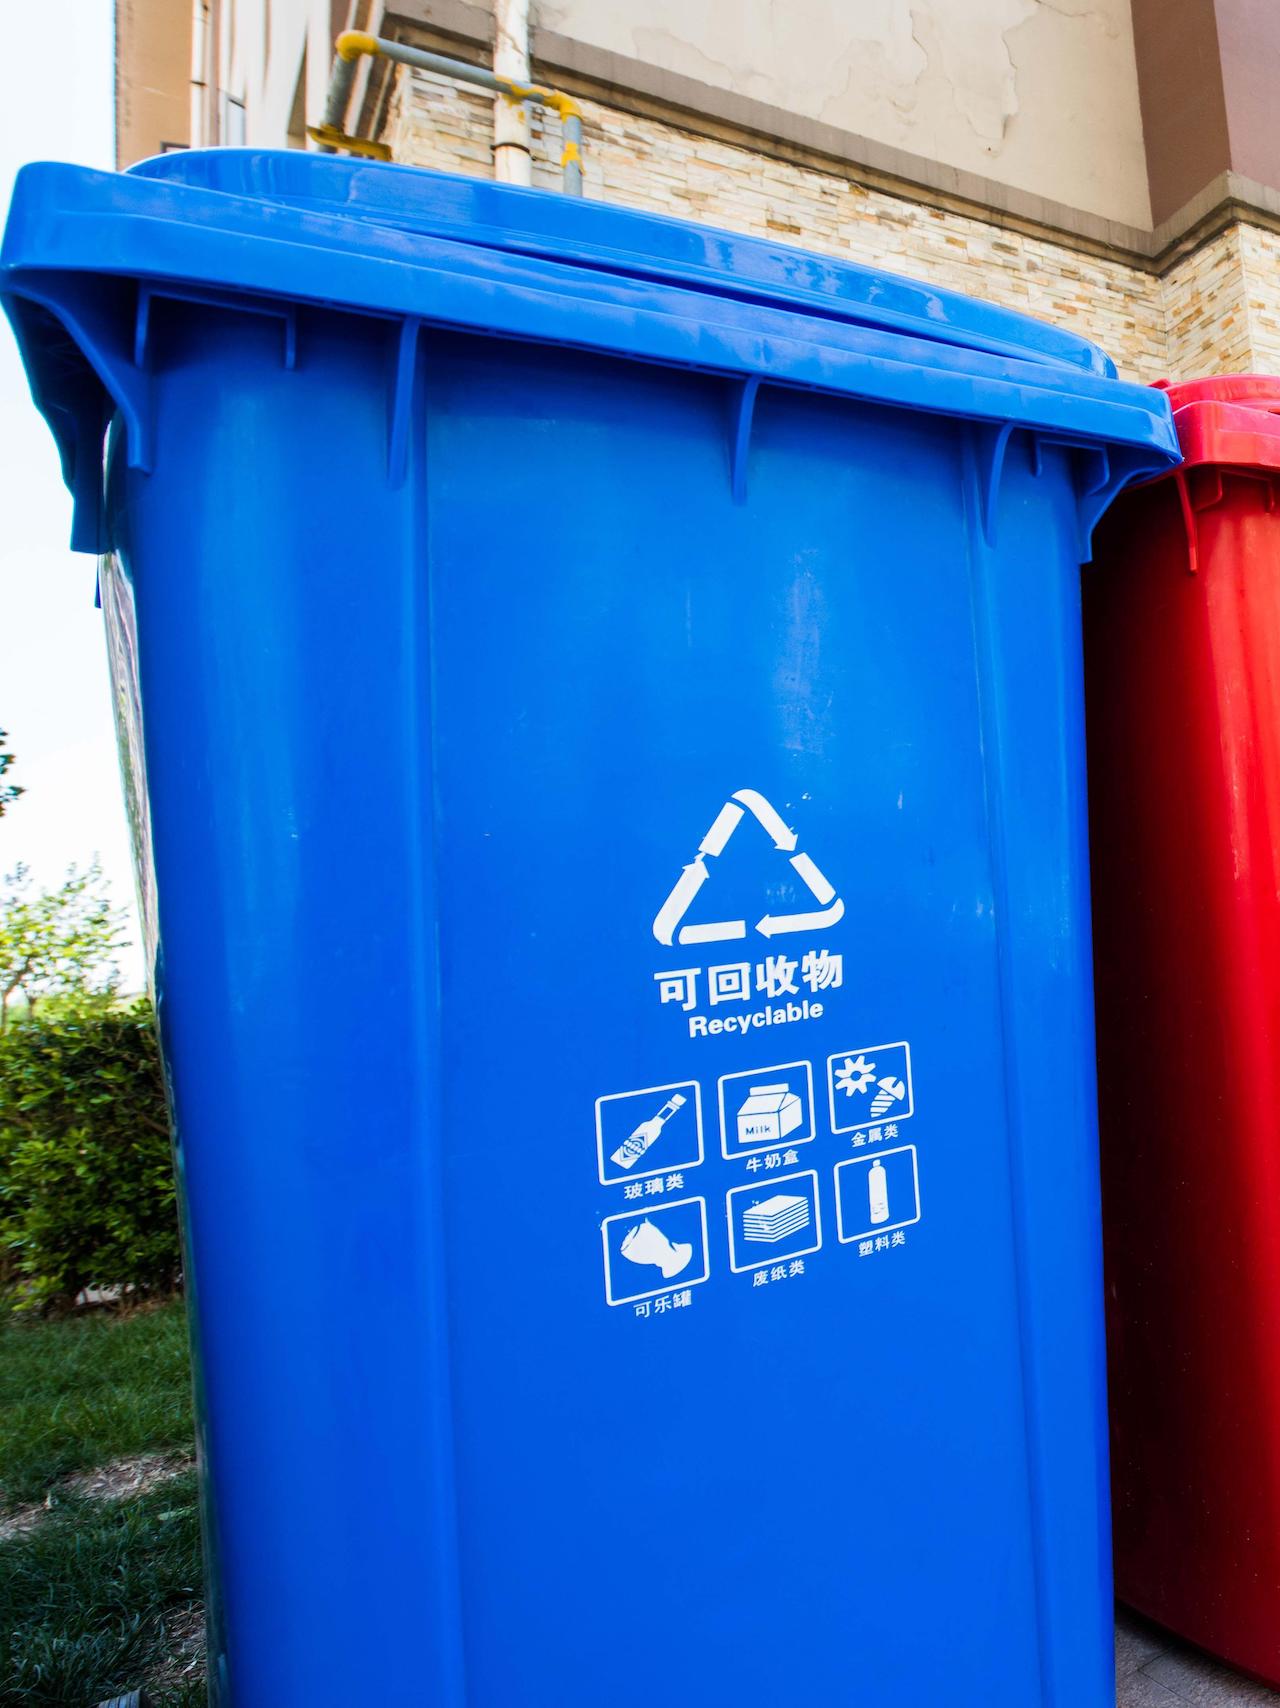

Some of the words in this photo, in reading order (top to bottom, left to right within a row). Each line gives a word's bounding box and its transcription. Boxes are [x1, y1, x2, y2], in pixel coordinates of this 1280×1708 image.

[653, 950, 843, 1011] 可回收物
[688, 1000, 824, 1038] Recyclable
[745, 1124, 772, 1137] Milk
[851, 1123, 900, 1148] 金属类
[745, 1149, 800, 1174] 牛奶盒
[623, 1173, 685, 1201] 玻璃类
[857, 1230, 907, 1258] 塑料类
[752, 1259, 806, 1288] 废纸类
[633, 1289, 693, 1320] 可乐罐
